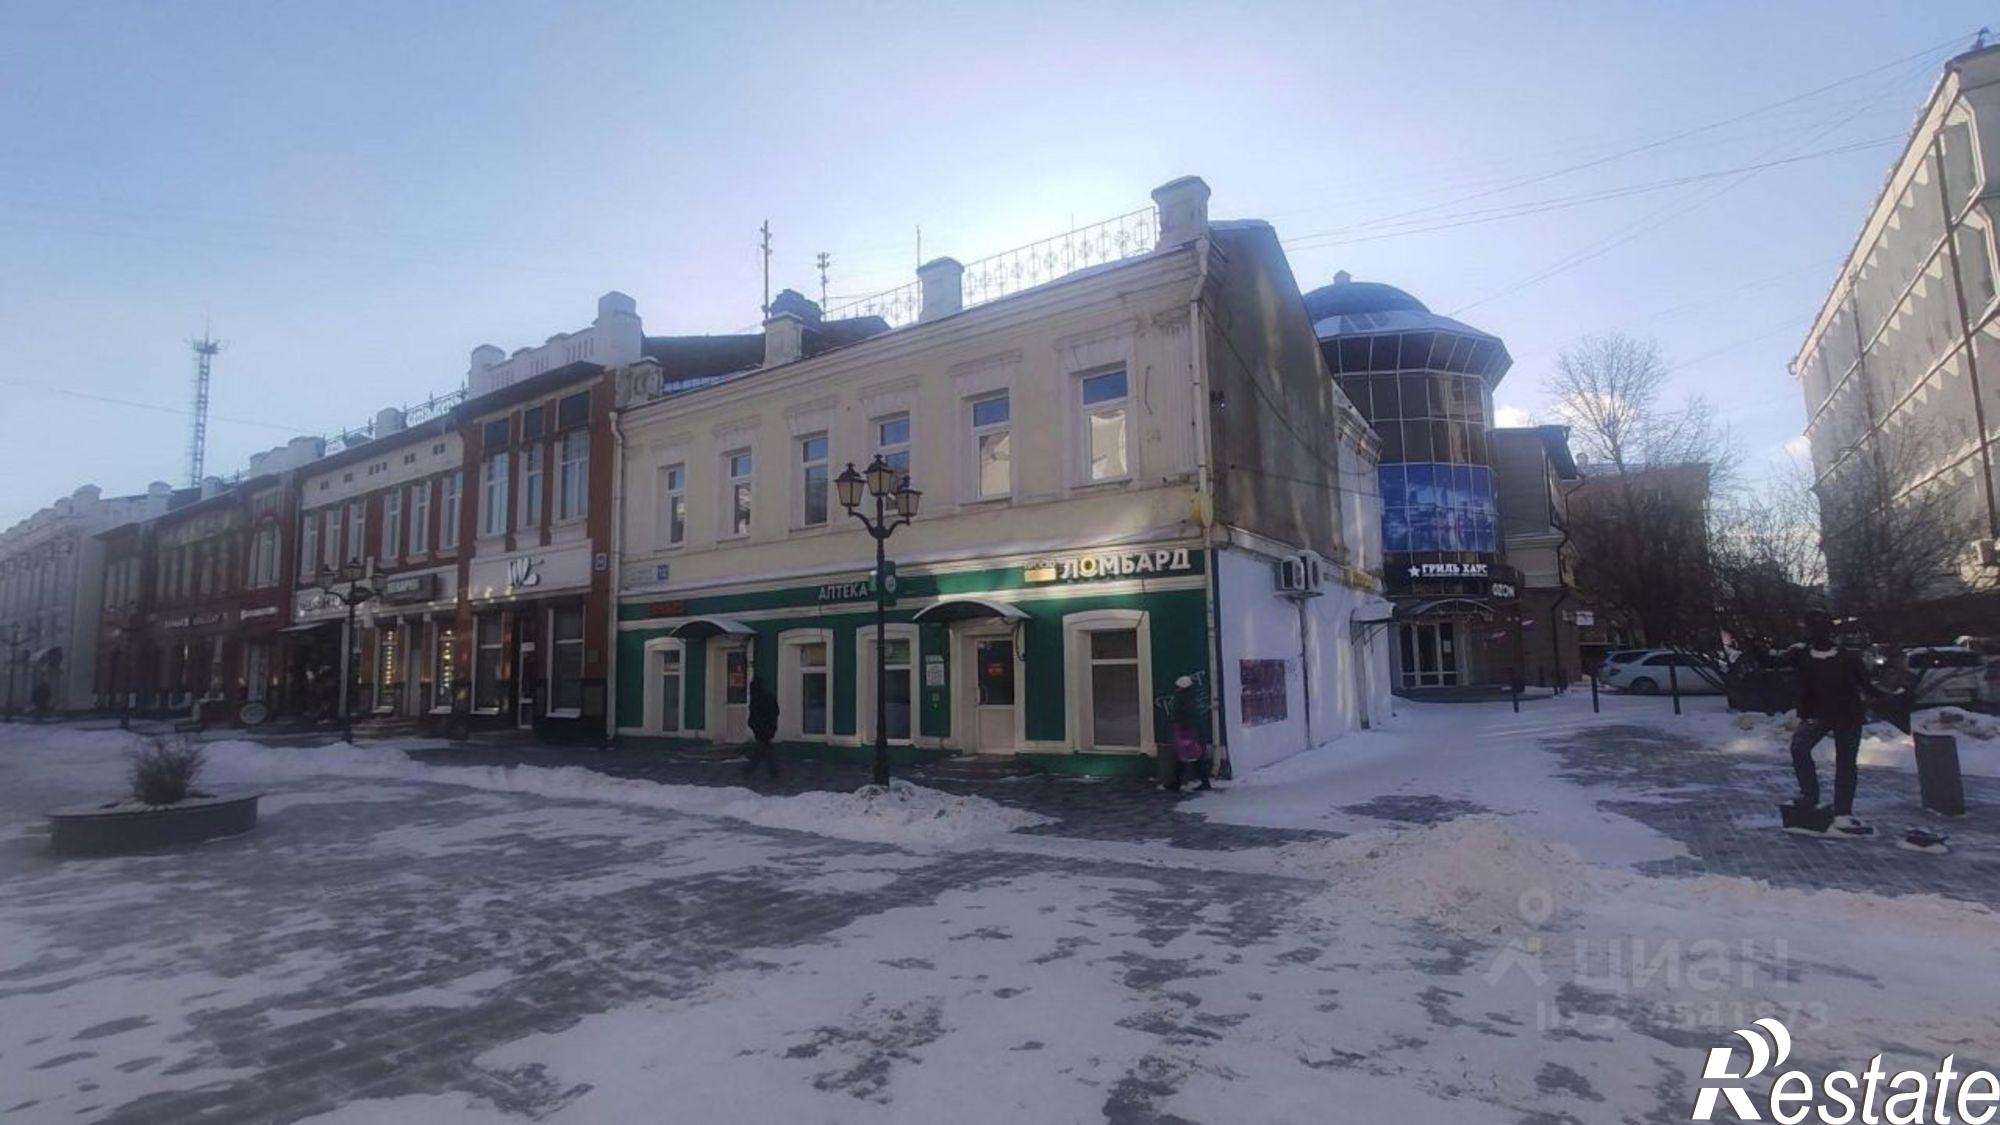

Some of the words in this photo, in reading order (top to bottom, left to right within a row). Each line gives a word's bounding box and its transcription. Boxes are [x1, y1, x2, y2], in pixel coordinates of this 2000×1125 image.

[1061, 548, 1191, 580] ЛОМБАРД
[1422, 563, 1460, 573] ГРИЛЬ
[1462, 563, 1488, 573] ХАУС
[818, 582, 868, 600] АПТЕКА
